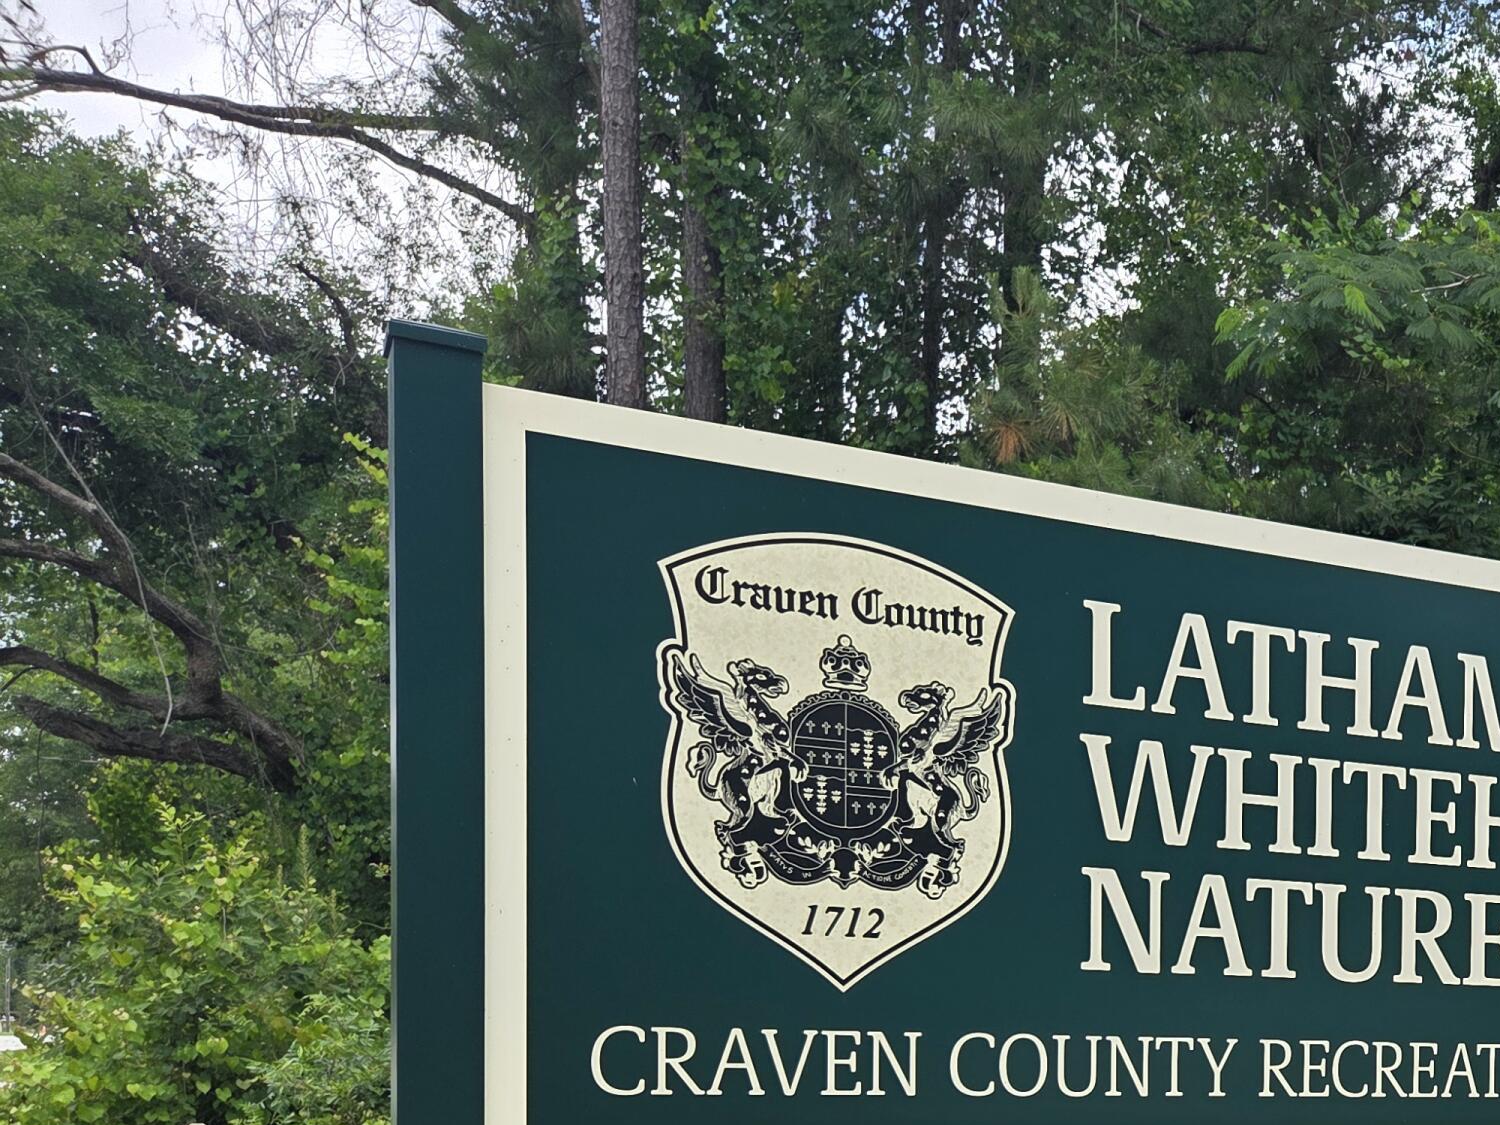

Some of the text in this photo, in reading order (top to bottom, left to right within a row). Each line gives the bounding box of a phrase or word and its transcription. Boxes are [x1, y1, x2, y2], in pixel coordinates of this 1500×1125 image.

[695, 564, 985, 647] Craven County
[801, 904, 885, 938] 1712
[590, 1025, 923, 1097] CRAVEN
[949, 1032, 1239, 1098] COUNTY
